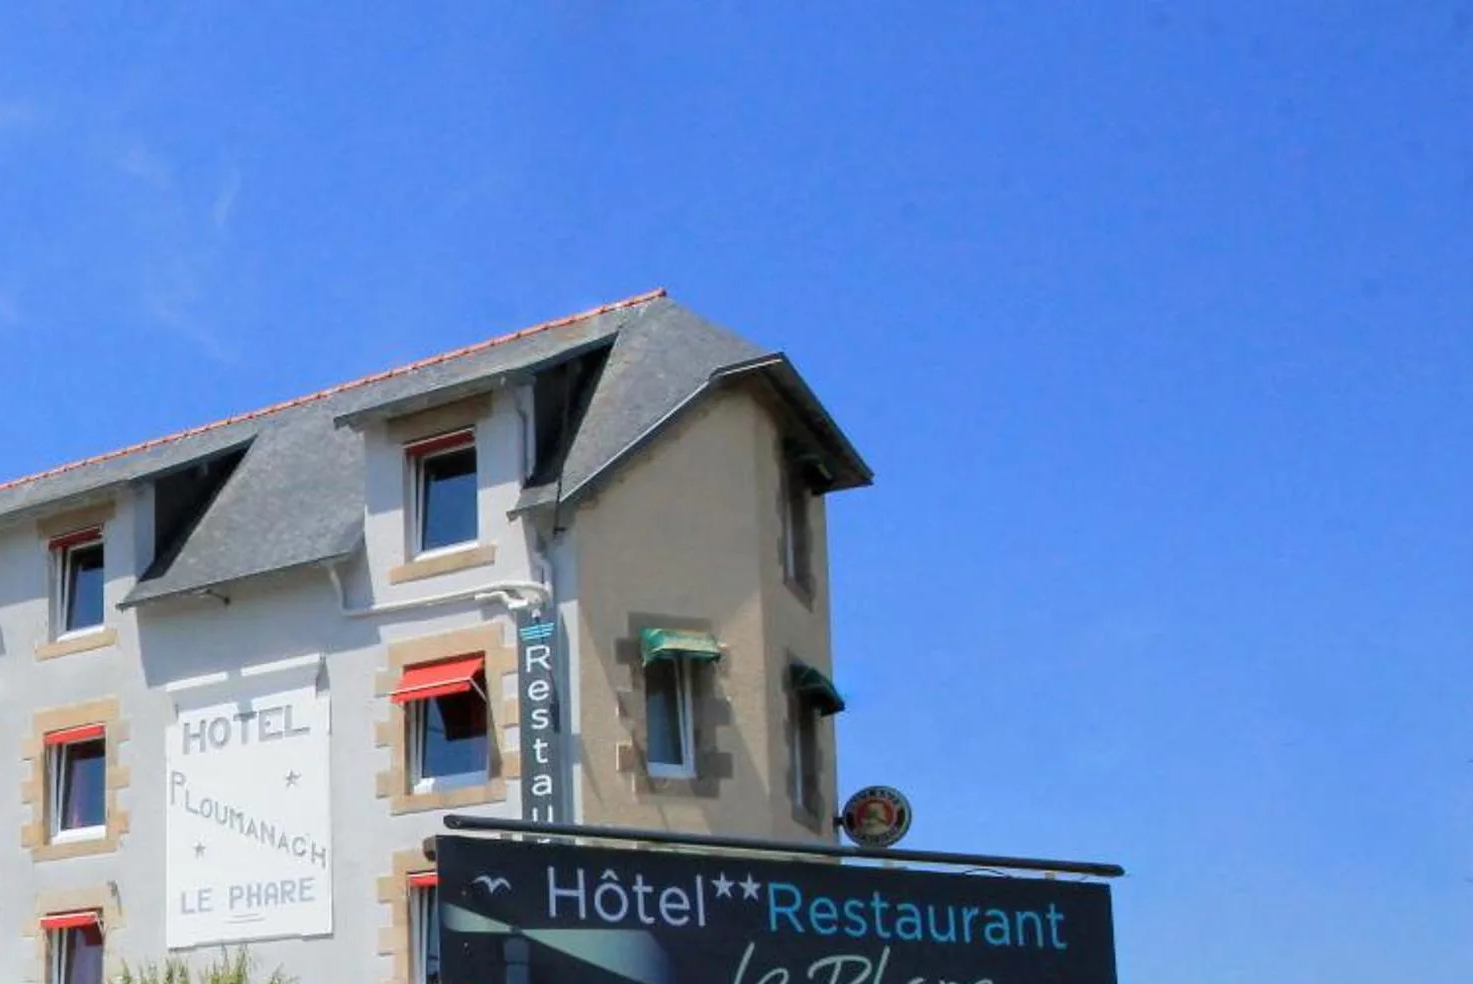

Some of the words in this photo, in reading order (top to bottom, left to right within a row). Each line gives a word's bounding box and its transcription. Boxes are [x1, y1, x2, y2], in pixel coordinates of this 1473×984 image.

[182, 704, 311, 755] HOTEL
[180, 888, 213, 915] LE
[228, 876, 316, 910] PHARE
[547, 865, 707, 927] Hôtel
[766, 882, 1069, 951] Restaurant
